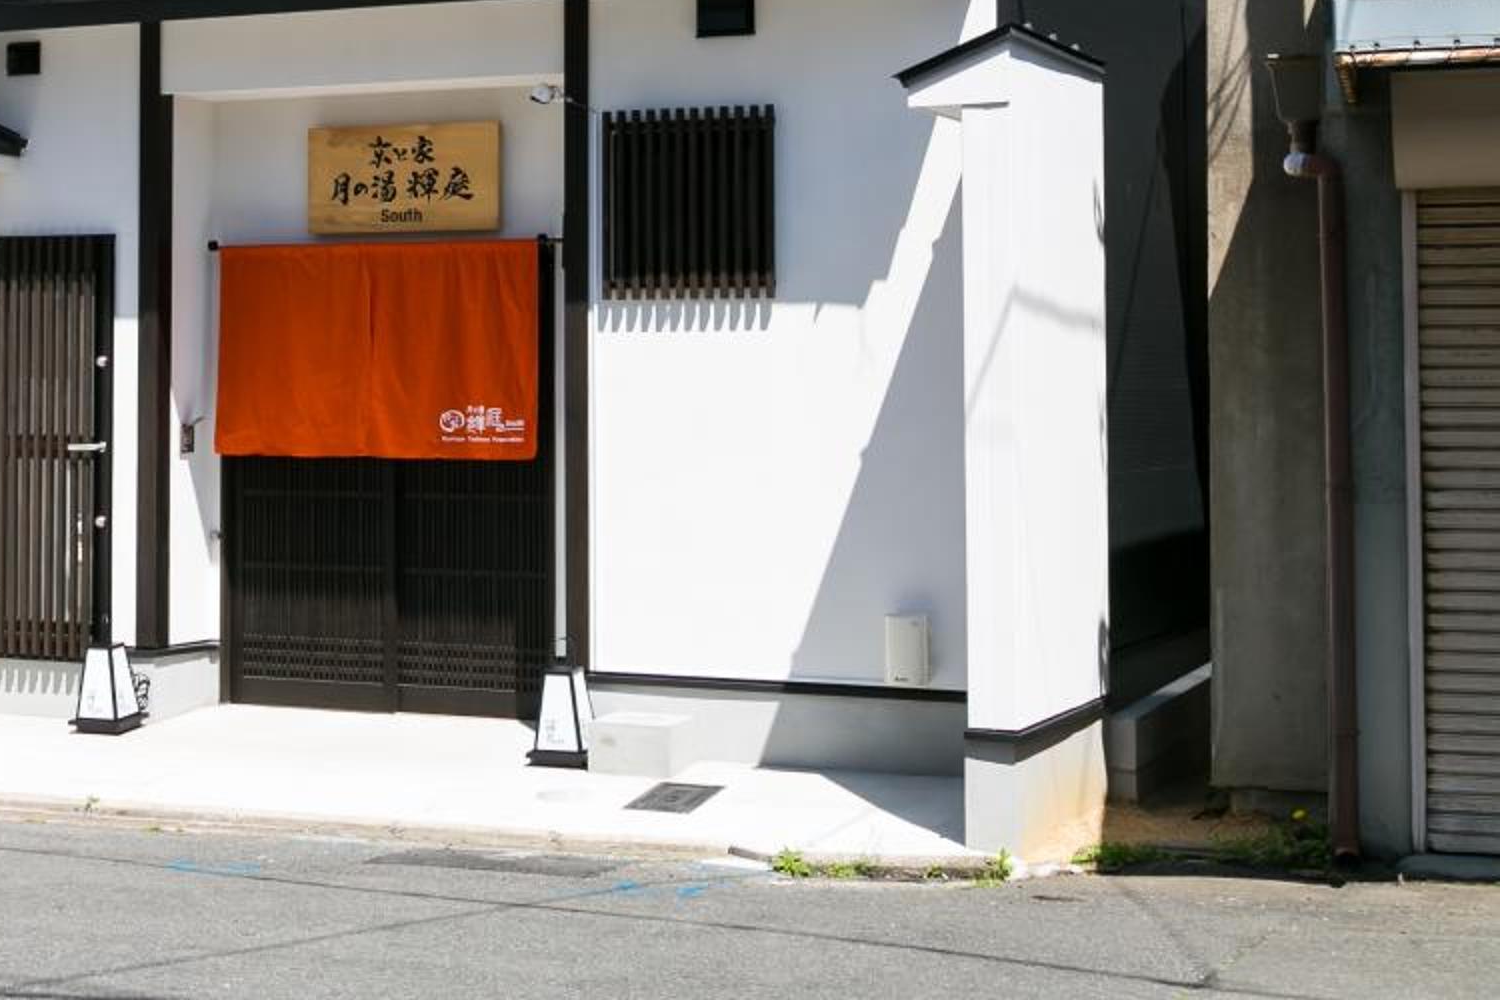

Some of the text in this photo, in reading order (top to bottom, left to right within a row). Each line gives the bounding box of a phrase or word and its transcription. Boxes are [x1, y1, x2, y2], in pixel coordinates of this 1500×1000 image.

[331, 169, 397, 206] 月の湯
[380, 208, 424, 223] South
